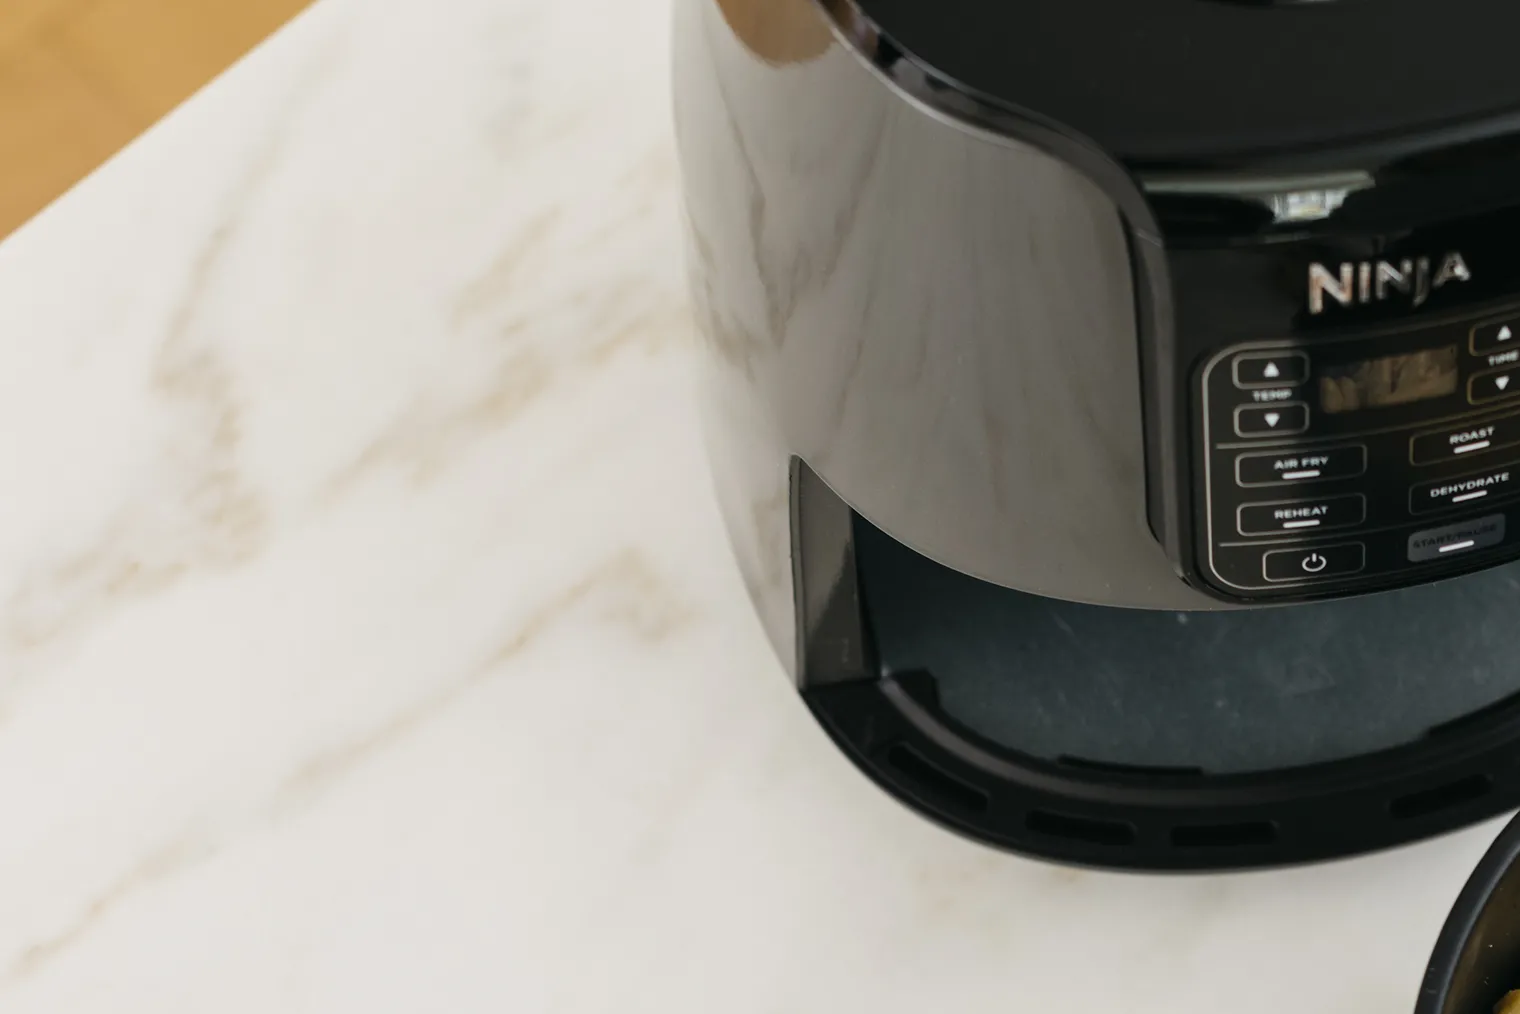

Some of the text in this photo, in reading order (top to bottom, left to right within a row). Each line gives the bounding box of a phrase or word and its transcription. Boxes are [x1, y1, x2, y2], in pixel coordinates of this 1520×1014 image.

[1308, 251, 1472, 314] NINJA
[1488, 350, 1520, 367] TIME
[1252, 388, 1293, 403] TEMP
[1449, 426, 1495, 445] ROAST
[1274, 455, 1329, 471] AIR FRY
[1430, 472, 1510, 499] DEHYDRATE
[1274, 505, 1329, 520] REHEAT
